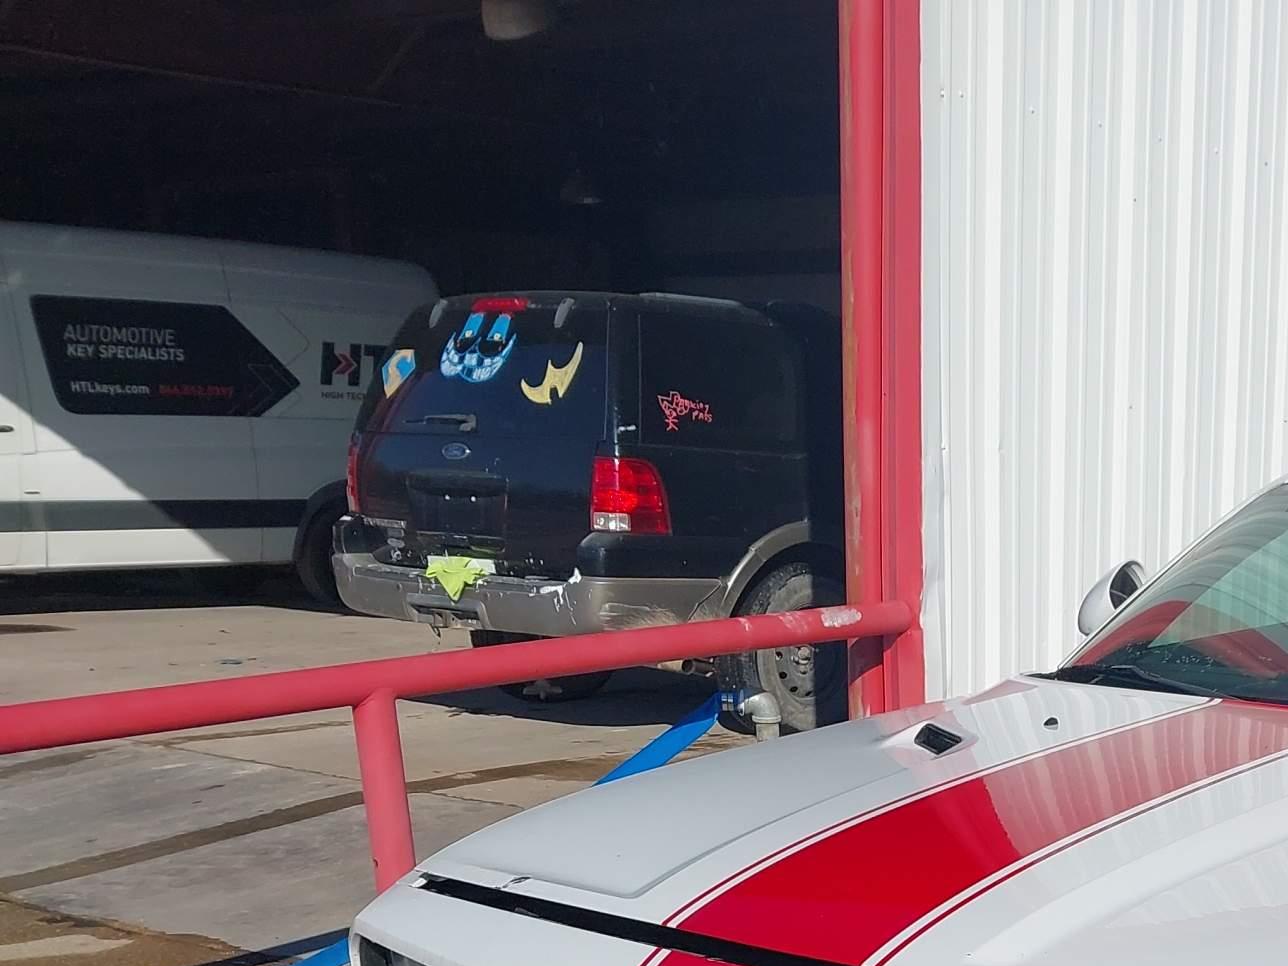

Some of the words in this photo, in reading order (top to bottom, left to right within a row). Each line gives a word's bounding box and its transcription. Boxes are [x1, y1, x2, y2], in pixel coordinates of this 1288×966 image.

[64, 324, 176, 346] AUTOMOTIVE
[67, 343, 94, 358] KEY
[99, 345, 185, 361] SPECIALISTS
[70, 381, 150, 396] HTLkeys.com
[321, 391, 344, 400] HIGH
